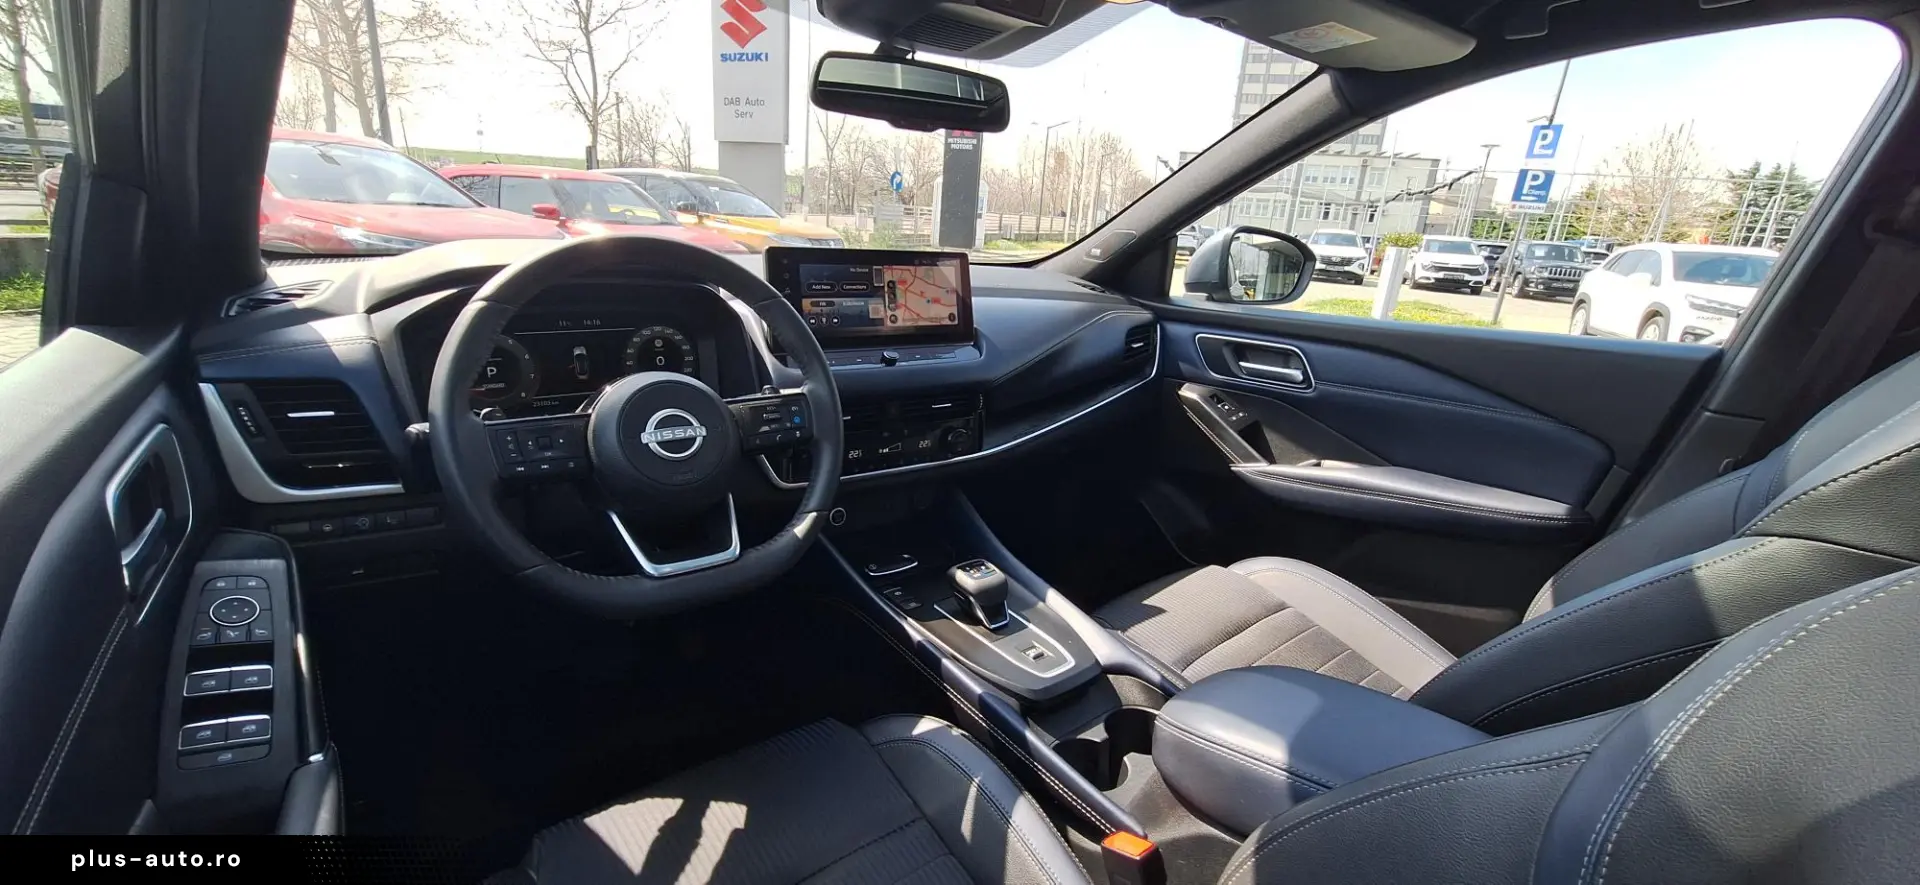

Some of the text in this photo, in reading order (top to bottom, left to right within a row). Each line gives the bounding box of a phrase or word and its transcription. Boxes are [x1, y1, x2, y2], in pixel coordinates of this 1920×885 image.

[720, 52, 769, 62] SUZUKI
[723, 97, 765, 107] DAB Auto
[734, 109, 754, 119] Serv
[1532, 129, 1554, 154] P
[1522, 170, 1546, 195] P
[656, 356, 665, 366] 0
[487, 366, 497, 378] P
[643, 427, 706, 443] NISSAN
